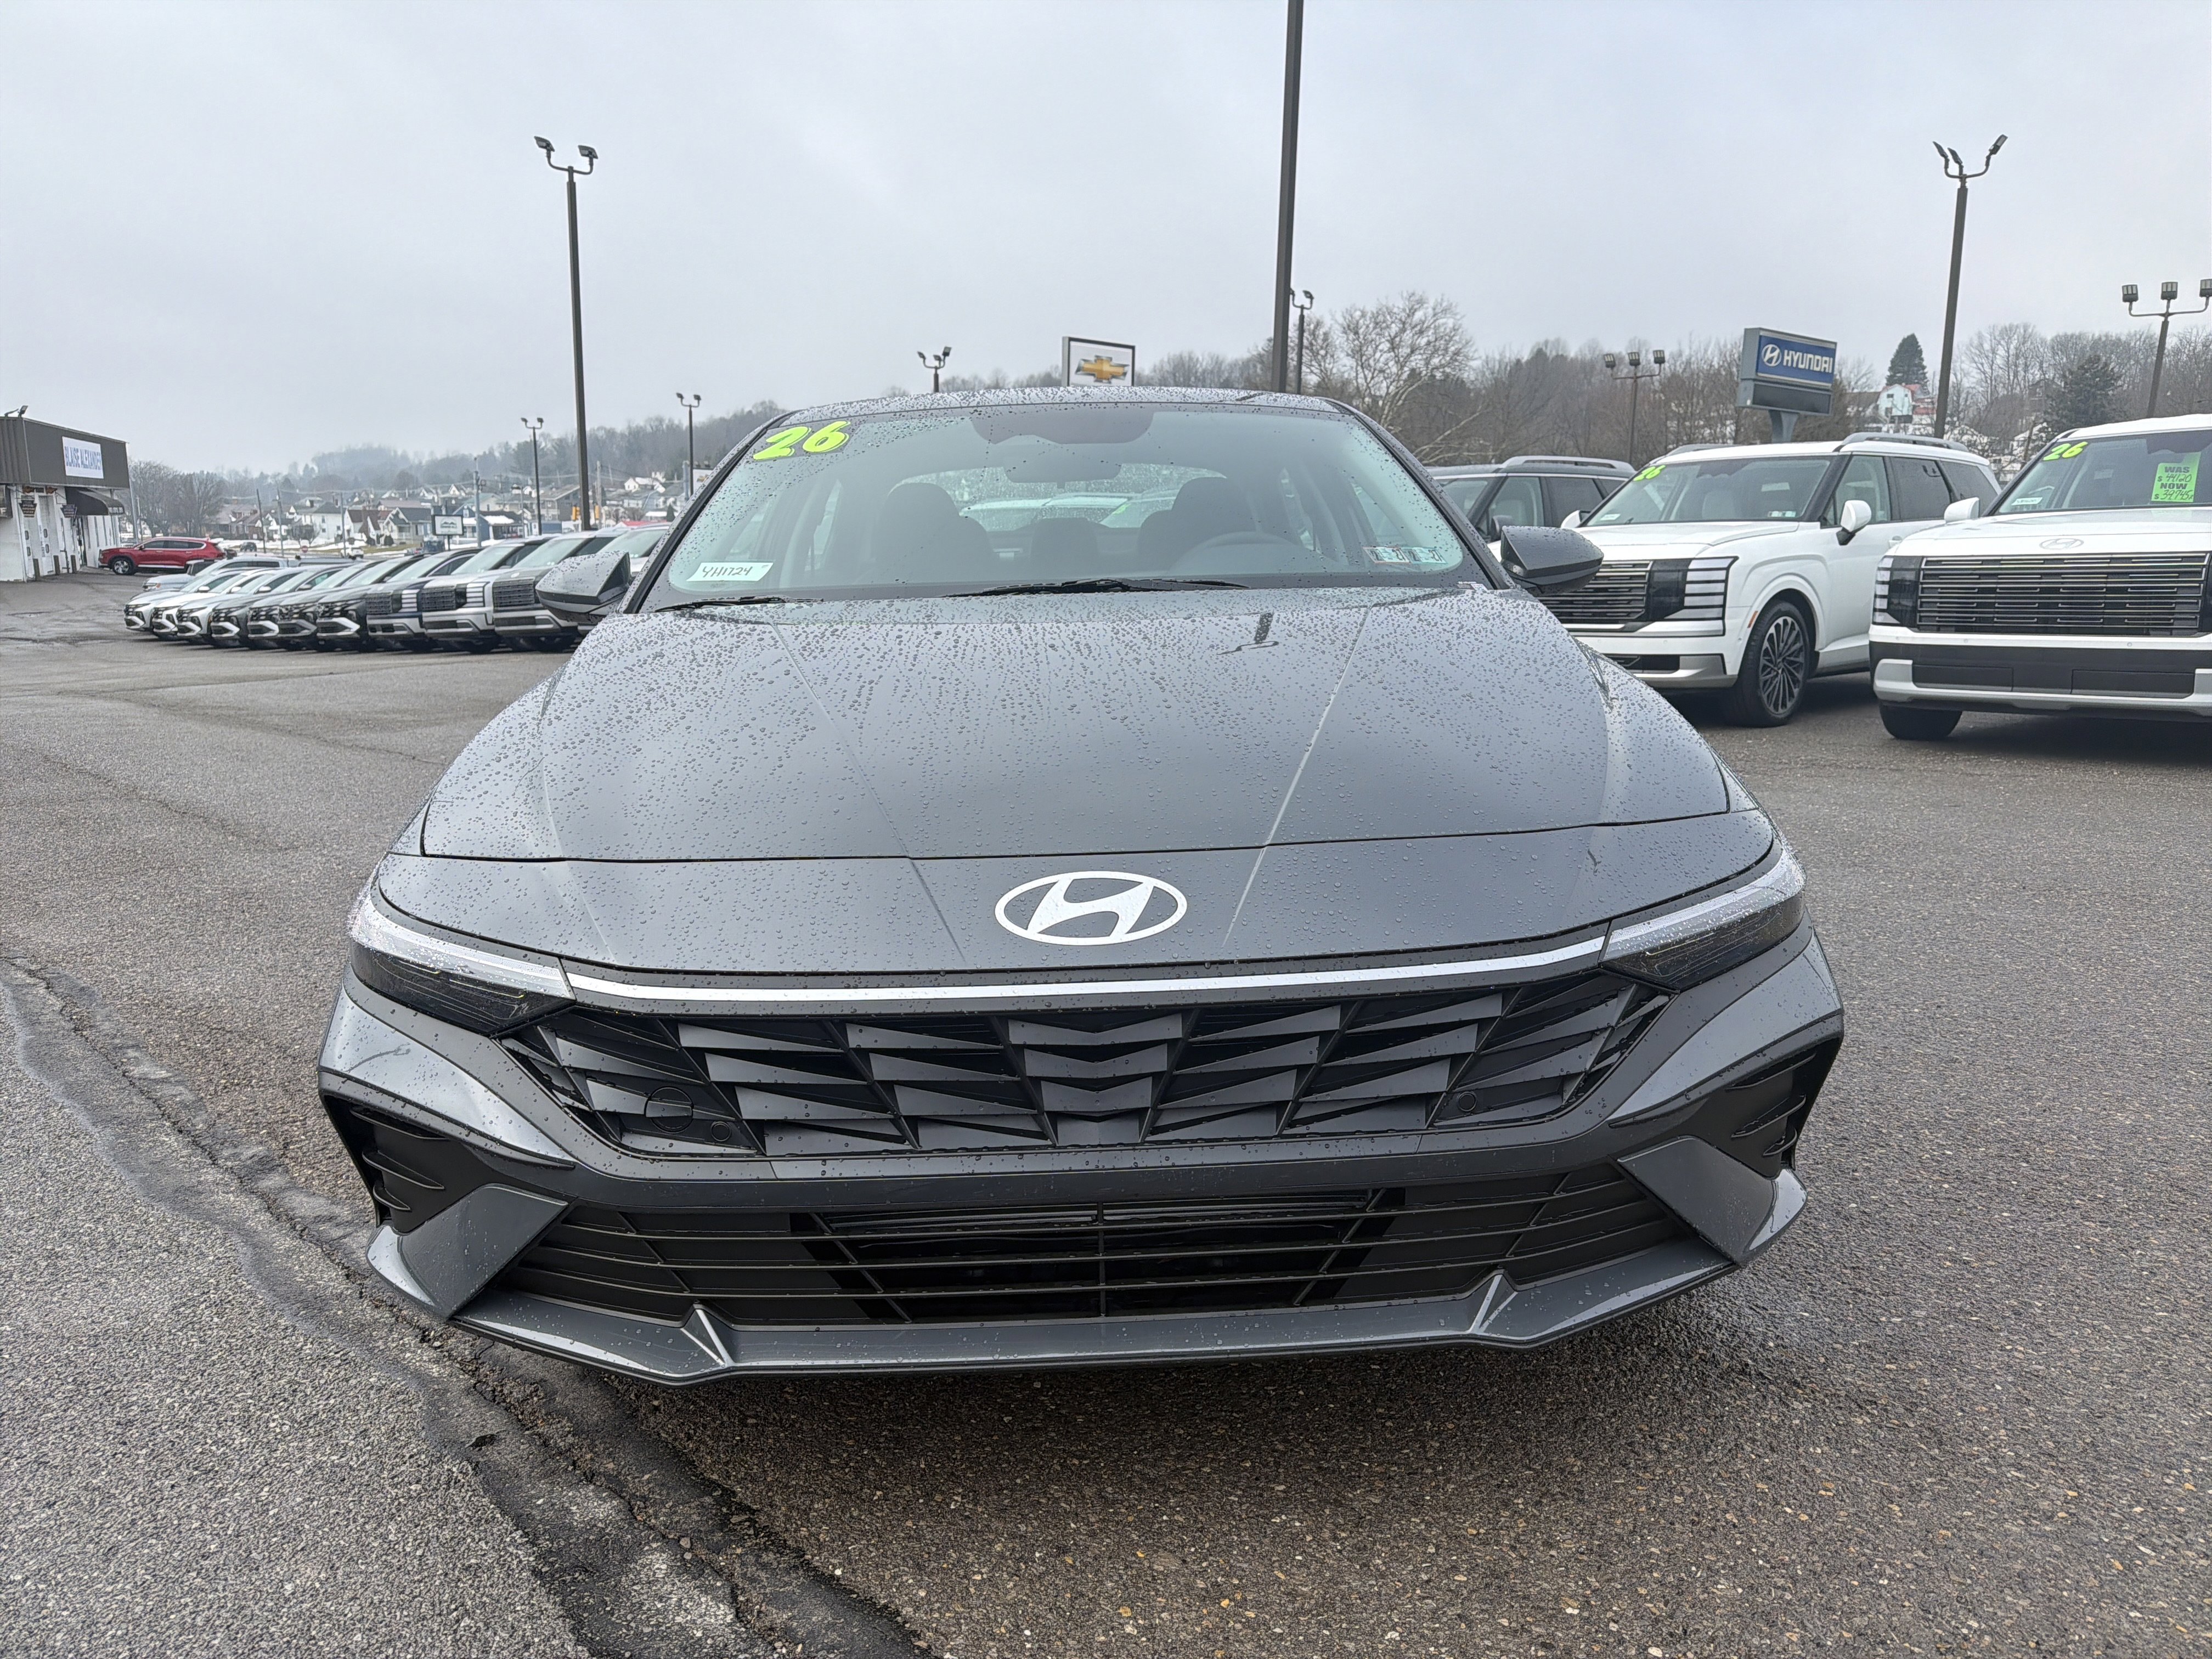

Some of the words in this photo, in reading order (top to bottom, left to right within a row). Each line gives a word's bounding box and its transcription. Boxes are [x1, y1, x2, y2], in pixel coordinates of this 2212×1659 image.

[1783, 349, 1833, 373] HYUNDAI
[753, 421, 851, 460] 26
[2043, 441, 2089, 461] 26
[1633, 465, 1666, 481] 26
